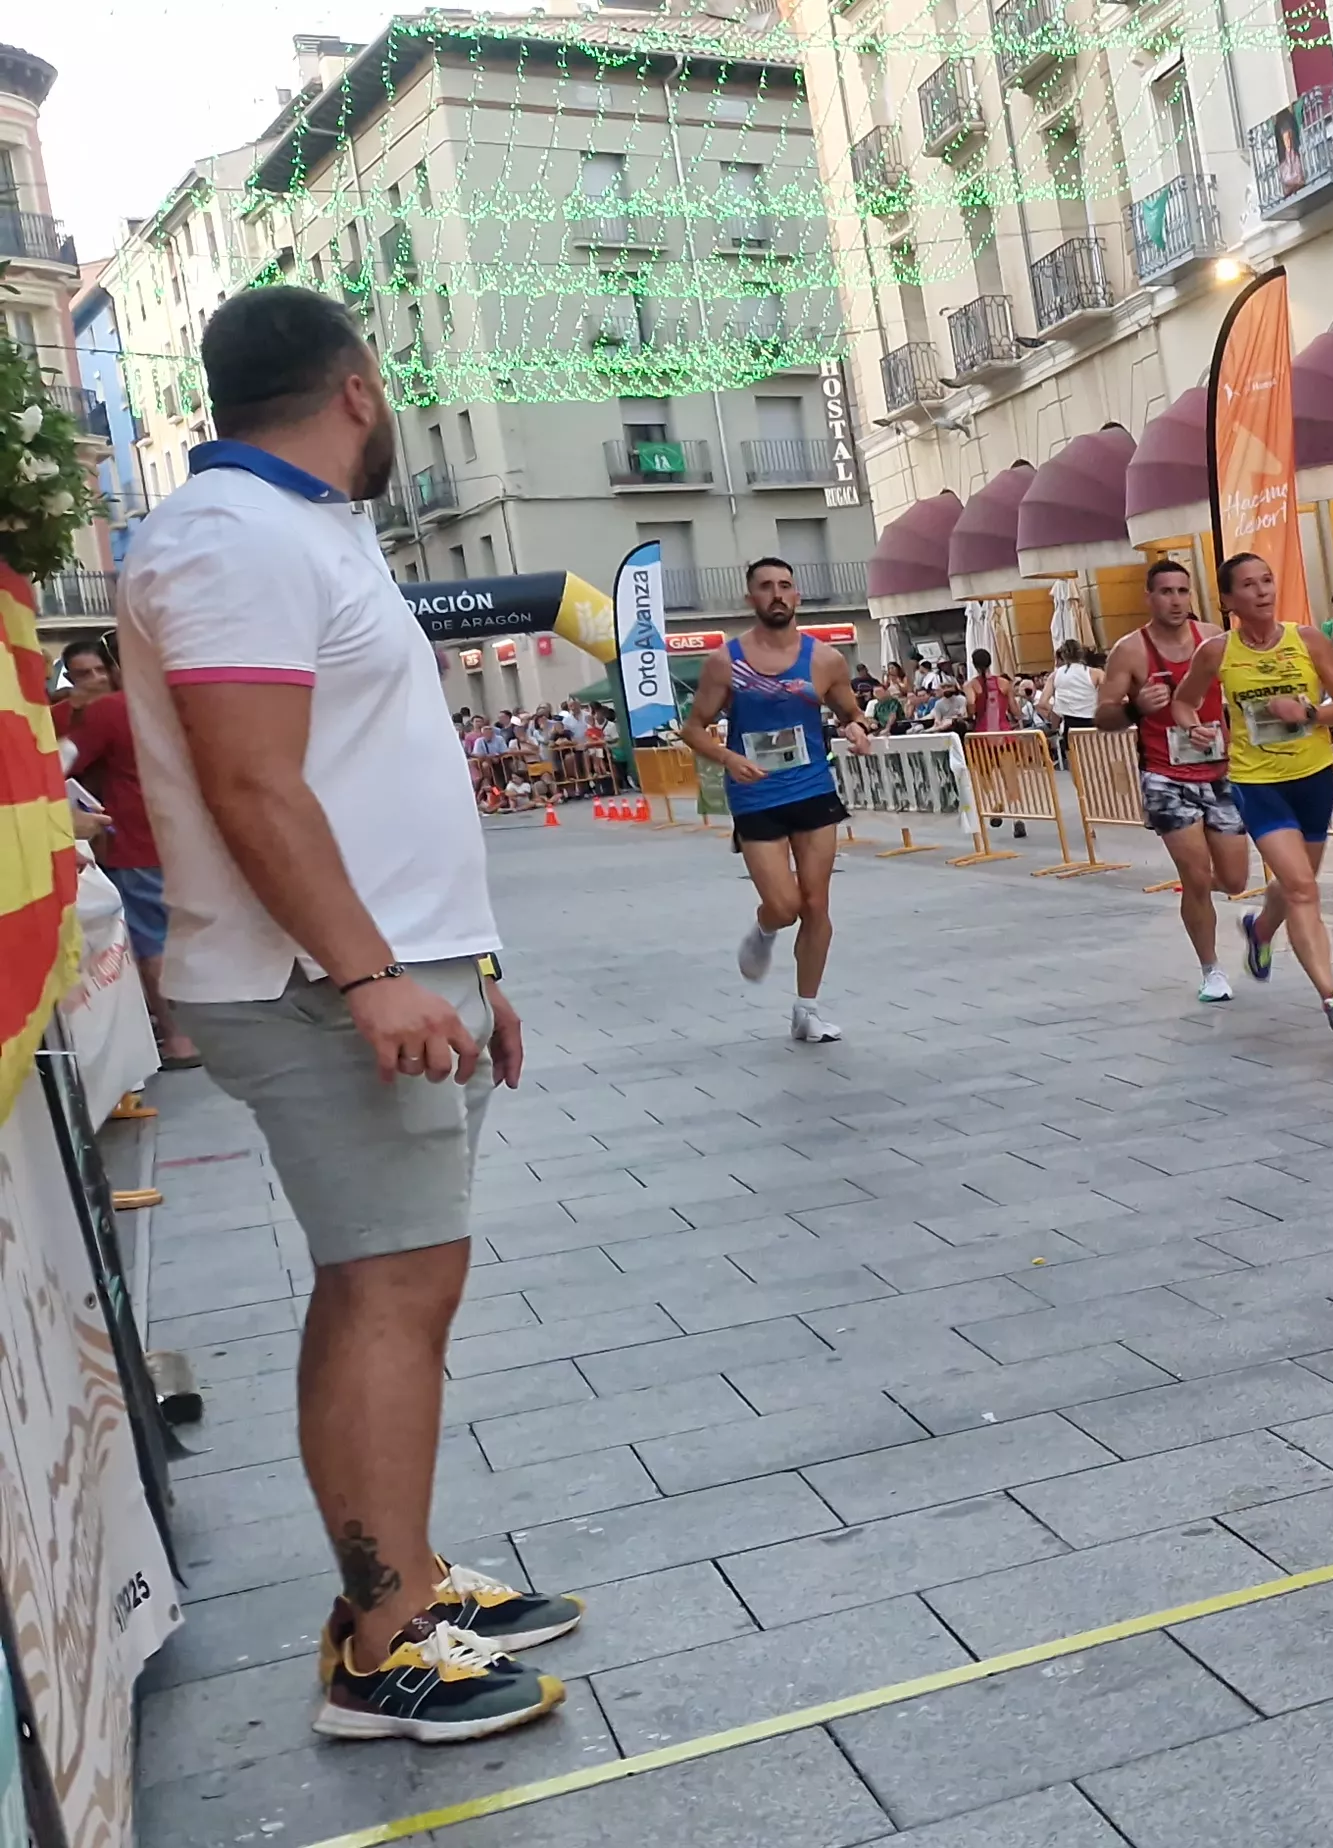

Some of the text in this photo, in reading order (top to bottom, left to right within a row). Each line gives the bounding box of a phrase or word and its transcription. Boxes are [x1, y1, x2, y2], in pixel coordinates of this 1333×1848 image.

[820, 357, 853, 482] HOSTAL
[431, 611, 532, 632] DE ARAGÓN
[633, 569, 658, 698] OrtoAvanza
[669, 636, 705, 650] GAES
